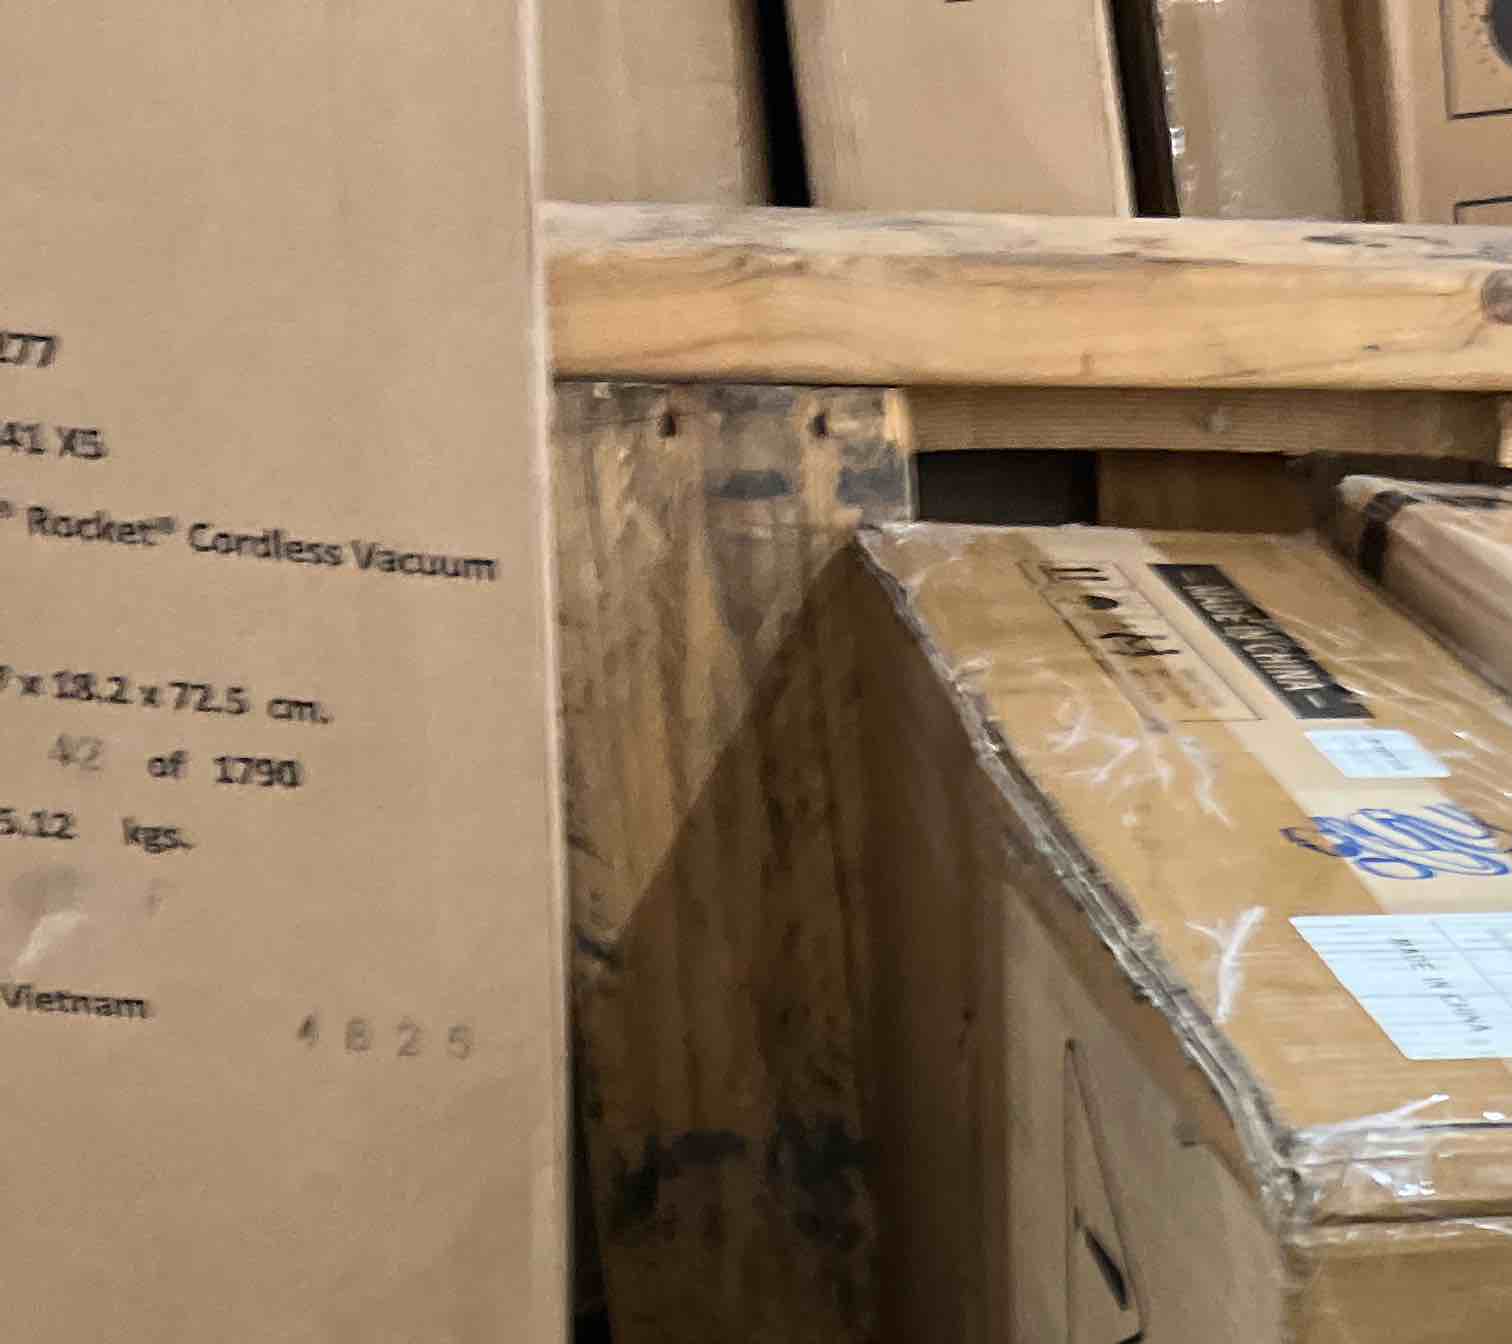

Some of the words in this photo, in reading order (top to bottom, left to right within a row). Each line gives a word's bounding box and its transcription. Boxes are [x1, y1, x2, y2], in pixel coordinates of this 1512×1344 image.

[187, 520, 343, 567] Cordless
[349, 538, 499, 582] Vacuum
[167, 680, 250, 715] 72.5
[147, 749, 191, 779] of
[213, 754, 304, 787] 1790
[0, 983, 150, 1020] Vietnam
